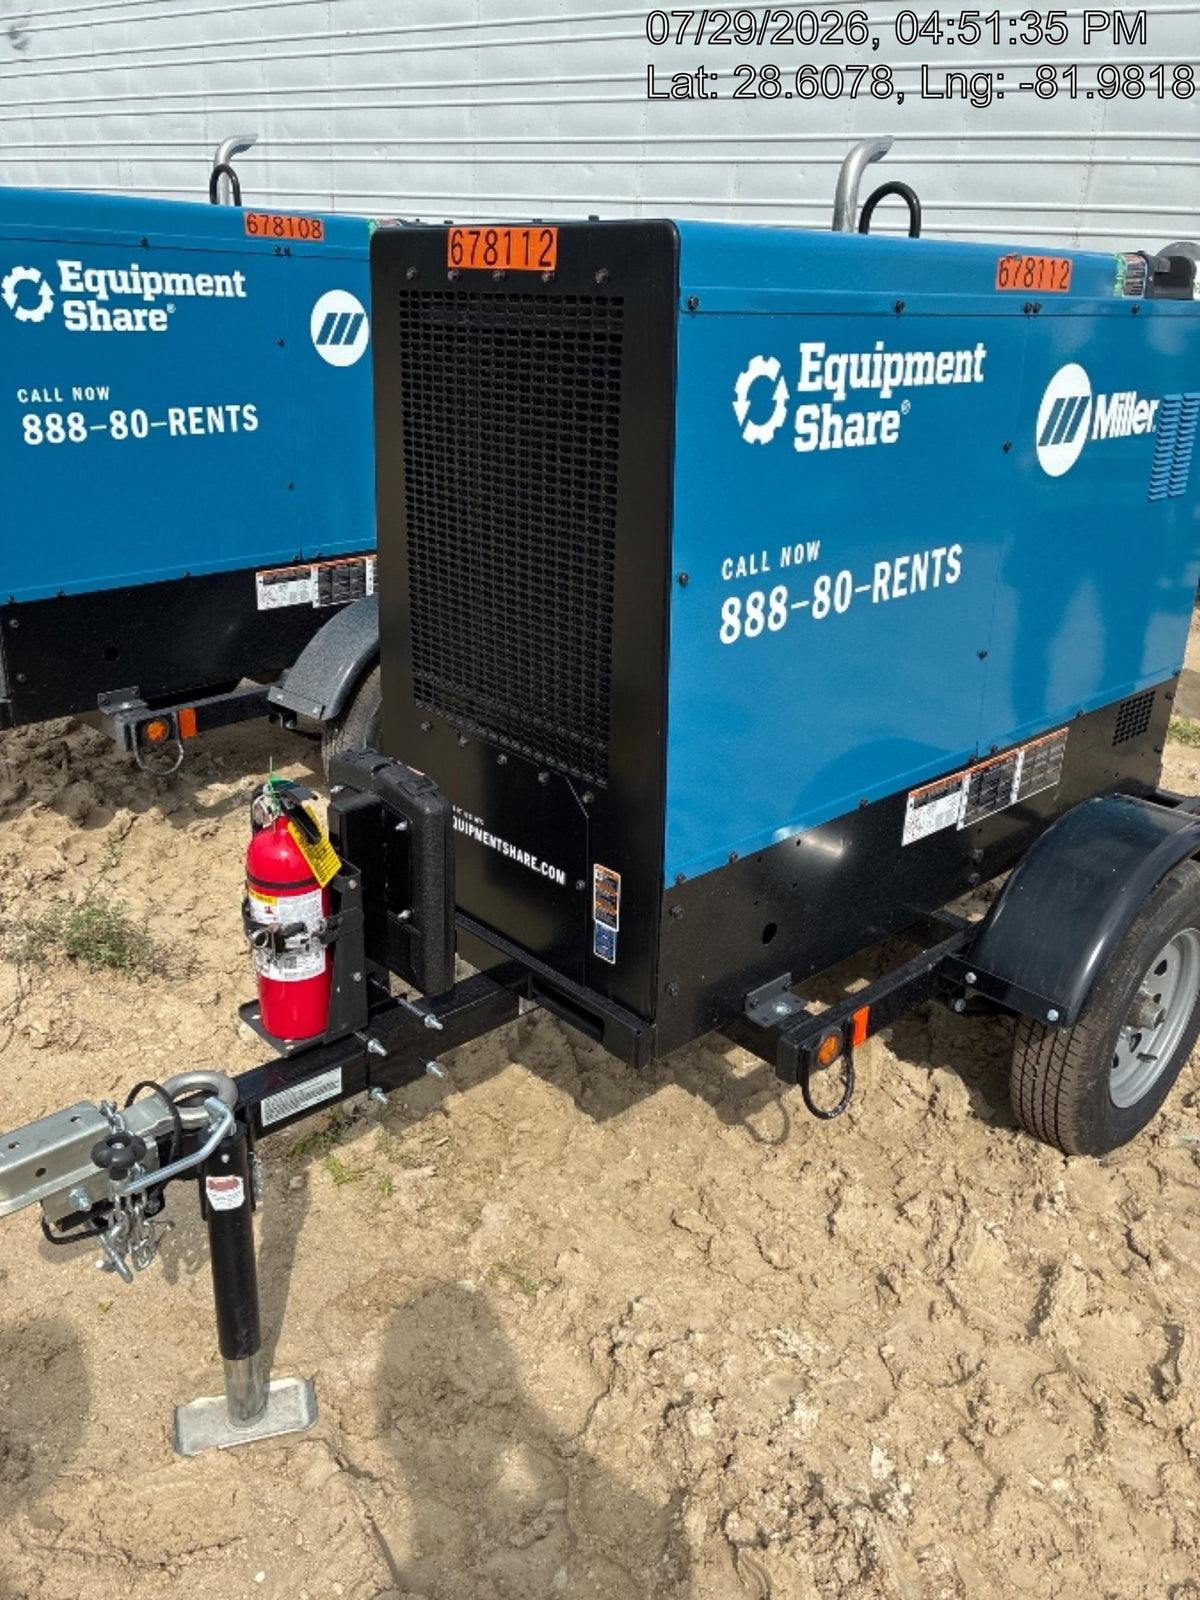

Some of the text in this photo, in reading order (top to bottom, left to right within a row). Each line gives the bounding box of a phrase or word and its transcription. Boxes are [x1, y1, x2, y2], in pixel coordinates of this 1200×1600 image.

[246, 213, 322, 240] 678108
[451, 229, 552, 267] 678112
[57, 259, 247, 301] Equipment
[999, 257, 1069, 289] 678112
[797, 341, 987, 401] Equipment
[17, 386, 110, 404] CALL NOW
[22, 403, 259, 446] 888-80-RENTS
[721, 539, 821, 581] CALL NOW
[719, 543, 963, 645] 888-80-RENTS
